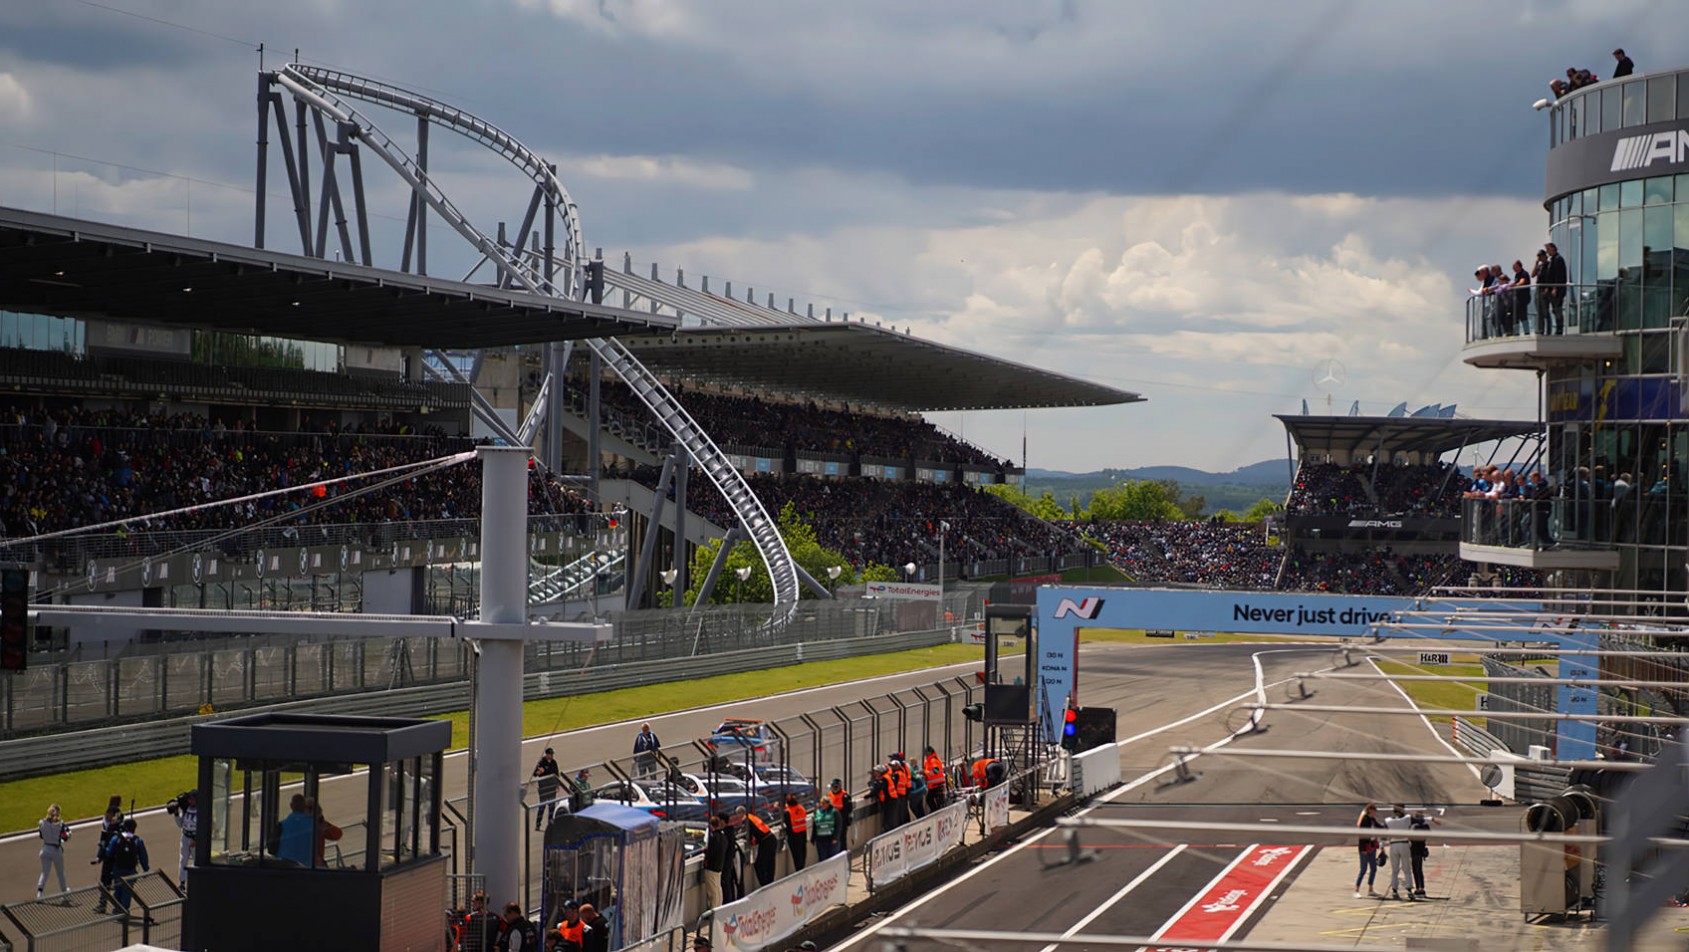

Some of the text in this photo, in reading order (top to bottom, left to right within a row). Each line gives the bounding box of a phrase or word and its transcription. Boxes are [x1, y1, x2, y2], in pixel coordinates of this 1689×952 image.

[1365, 520, 1402, 528] AMG
[887, 586, 940, 597] TotalEnergies
[1233, 604, 1295, 623] Never
[1296, 605, 1336, 626] just
